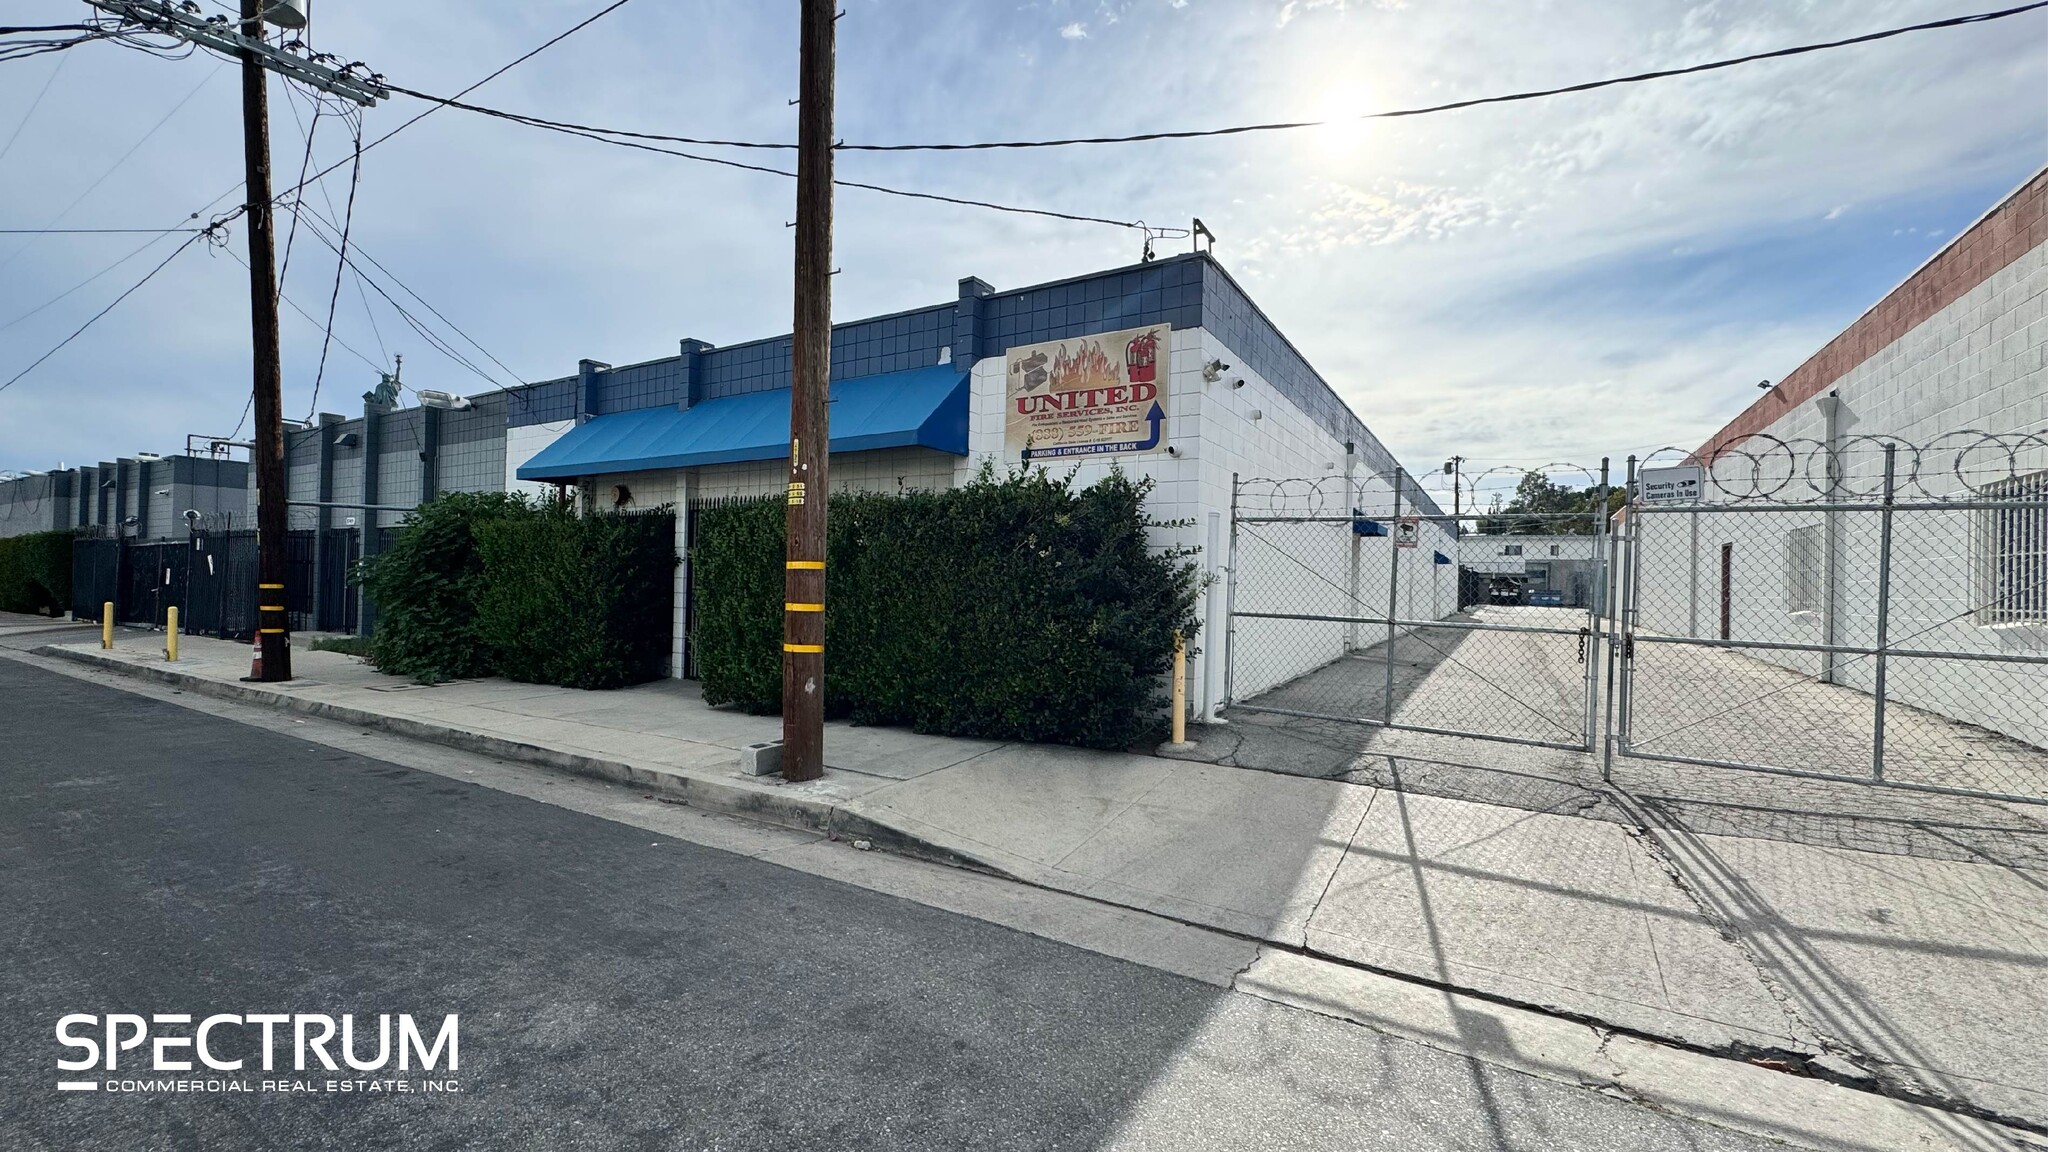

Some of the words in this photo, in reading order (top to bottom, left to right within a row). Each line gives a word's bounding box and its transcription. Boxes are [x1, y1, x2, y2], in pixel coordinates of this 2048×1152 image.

[1016, 383, 1157, 415] UNITED
[1029, 413, 1054, 422] FIRE
[1056, 407, 1113, 419] SERVICES,
[1115, 405, 1140, 413] INC.
[1030, 449, 1056, 458] PARKING
[1063, 445, 1096, 455] ENTRANCE
[1096, 444, 1104, 452] IN
[1104, 443, 1119, 452] THE
[1119, 442, 1137, 451] BACK
[1645, 482, 1675, 490] Security
[1646, 491, 1675, 500] Cameras
[1684, 488, 1698, 497] Use
